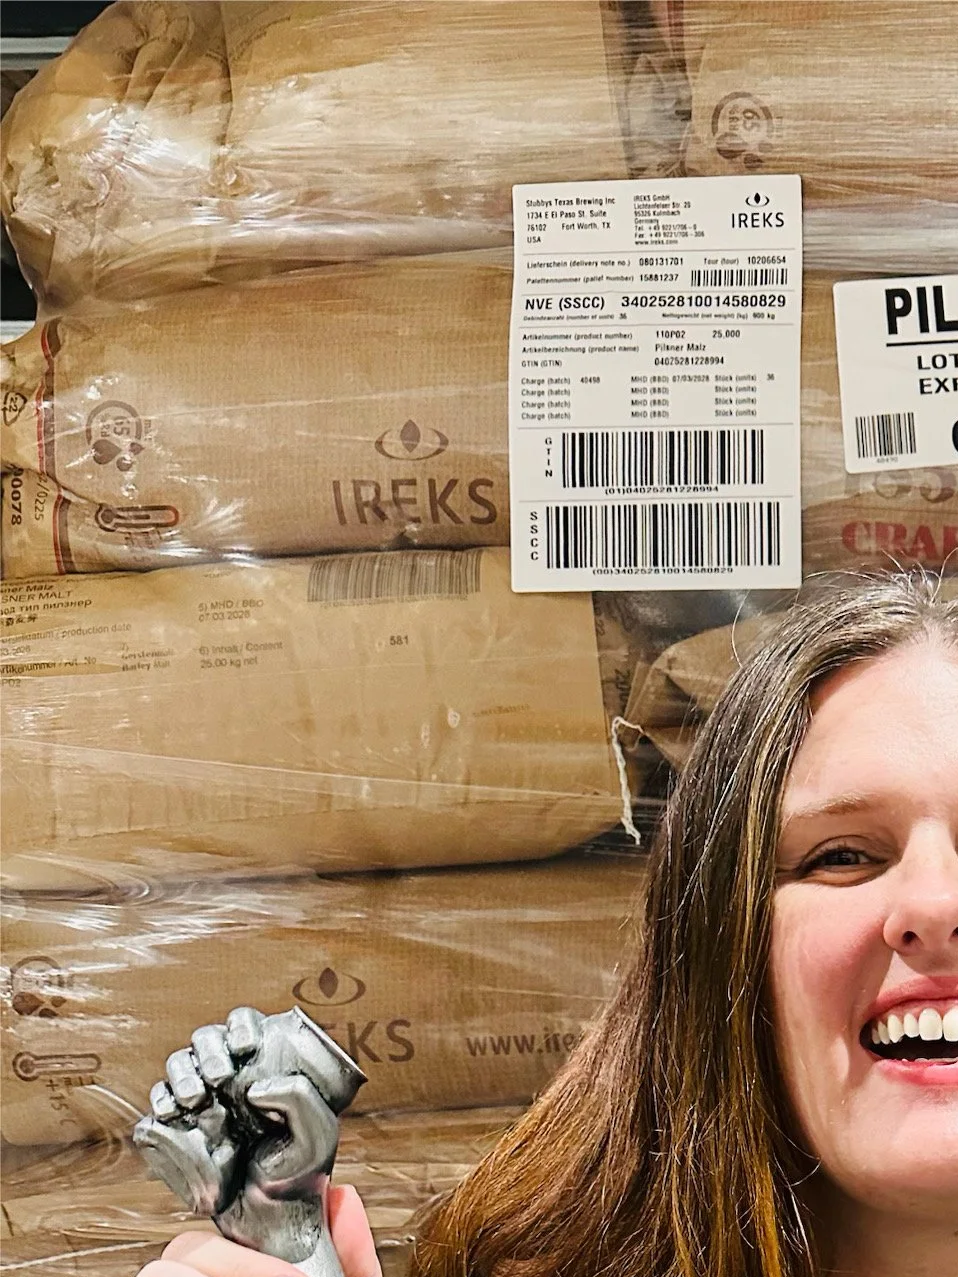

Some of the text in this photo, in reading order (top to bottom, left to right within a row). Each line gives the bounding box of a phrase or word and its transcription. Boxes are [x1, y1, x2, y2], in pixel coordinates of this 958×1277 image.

[526, 199, 552, 209] Stubbys
[576, 198, 603, 207] Brewing
[605, 197, 615, 205] Inc
[527, 211, 543, 220] 1734
[545, 211, 549, 219] E
[590, 209, 607, 218] Suite
[731, 212, 785, 228] IREKS
[527, 223, 547, 232] 76102
[561, 222, 575, 230] Fort
[602, 221, 611, 229] TX
[527, 236, 541, 244] USA
[527, 261, 567, 269] Lieferschein
[747, 256, 786, 265] 10206654
[525, 294, 786, 311] NVE (SSCC) 340252810014580829
[656, 330, 686, 339] 110P02
[655, 343, 684, 352] Pilsner
[687, 343, 706, 351] Malz
[521, 377, 545, 386] Charge
[521, 389, 545, 397] Charge
[521, 401, 545, 409] Charge
[521, 412, 545, 420] Charge
[332, 478, 498, 525] IREKS
[38, 590, 74, 600] MALT
[389, 635, 409, 646] 581
[230, 658, 241, 668] kg
